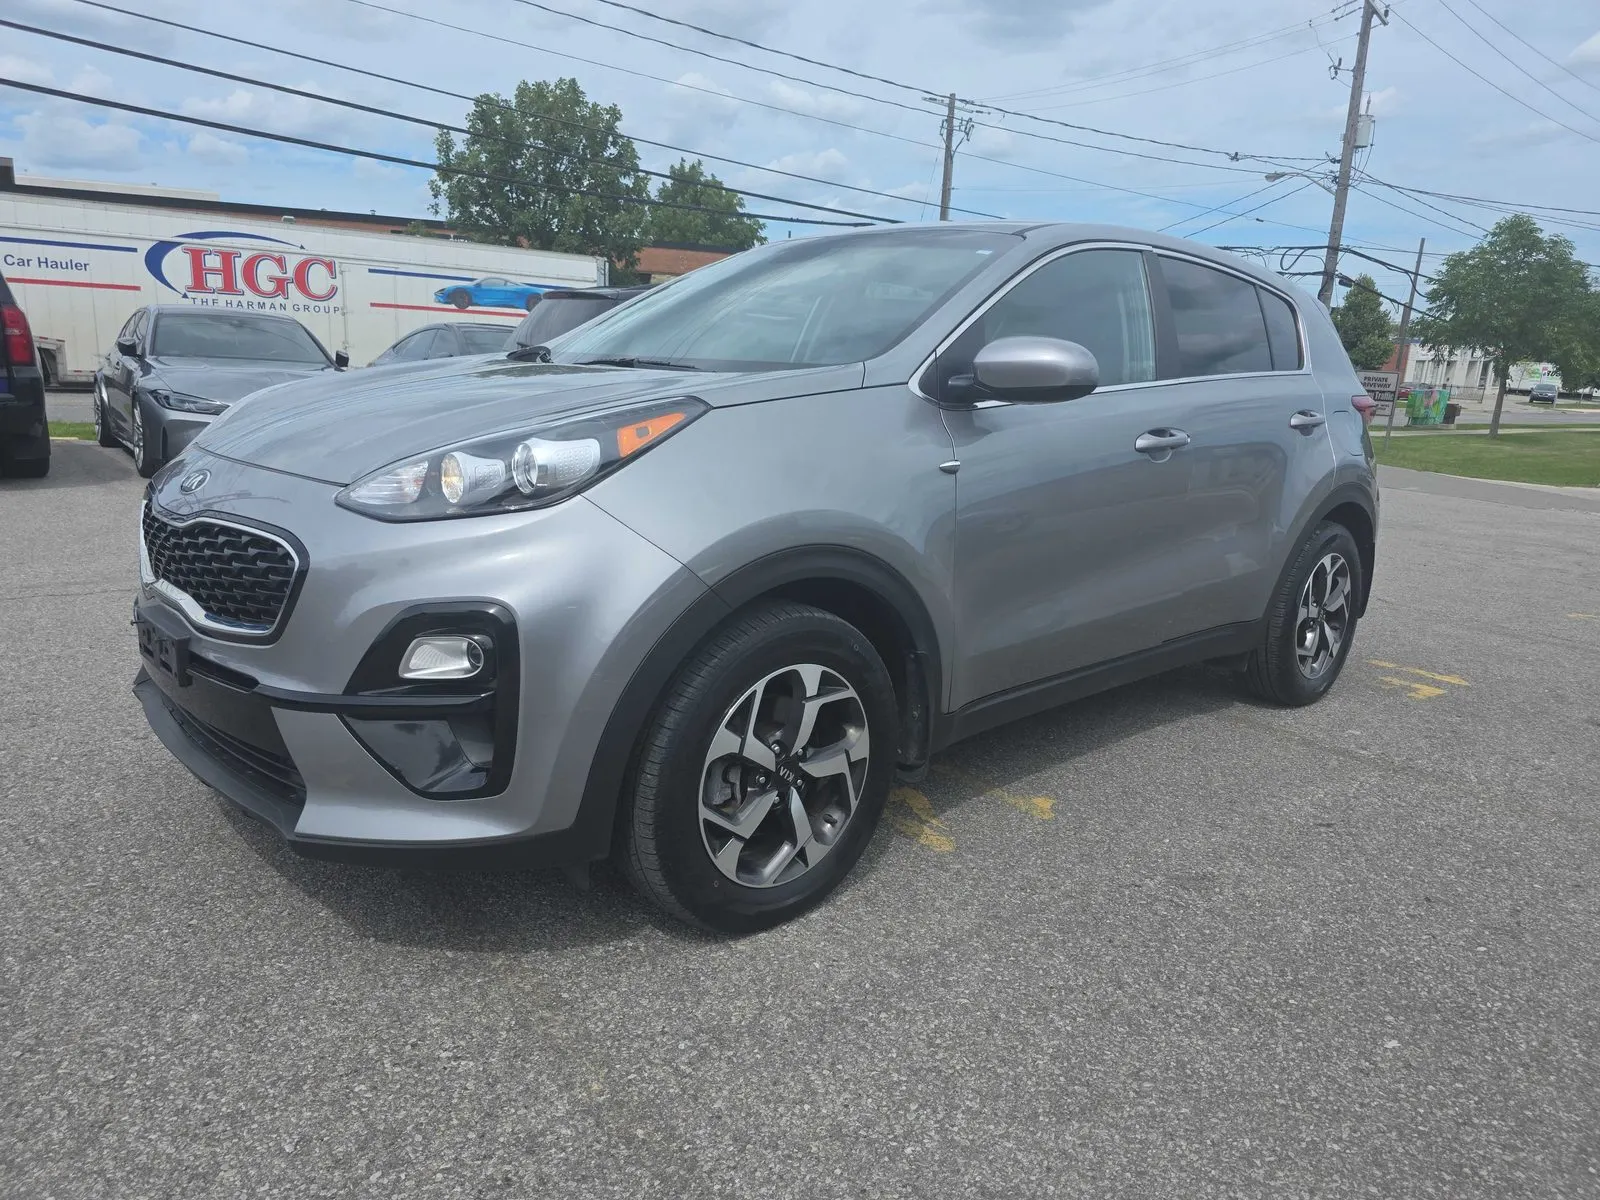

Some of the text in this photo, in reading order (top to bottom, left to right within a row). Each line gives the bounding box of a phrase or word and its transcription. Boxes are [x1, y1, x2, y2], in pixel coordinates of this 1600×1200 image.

[4, 254, 90, 271] Car Hauler
[182, 246, 338, 301] HGC
[225, 299, 287, 311] HARMAN
[292, 303, 340, 314] GROUP
[780, 766, 794, 782] KIA
